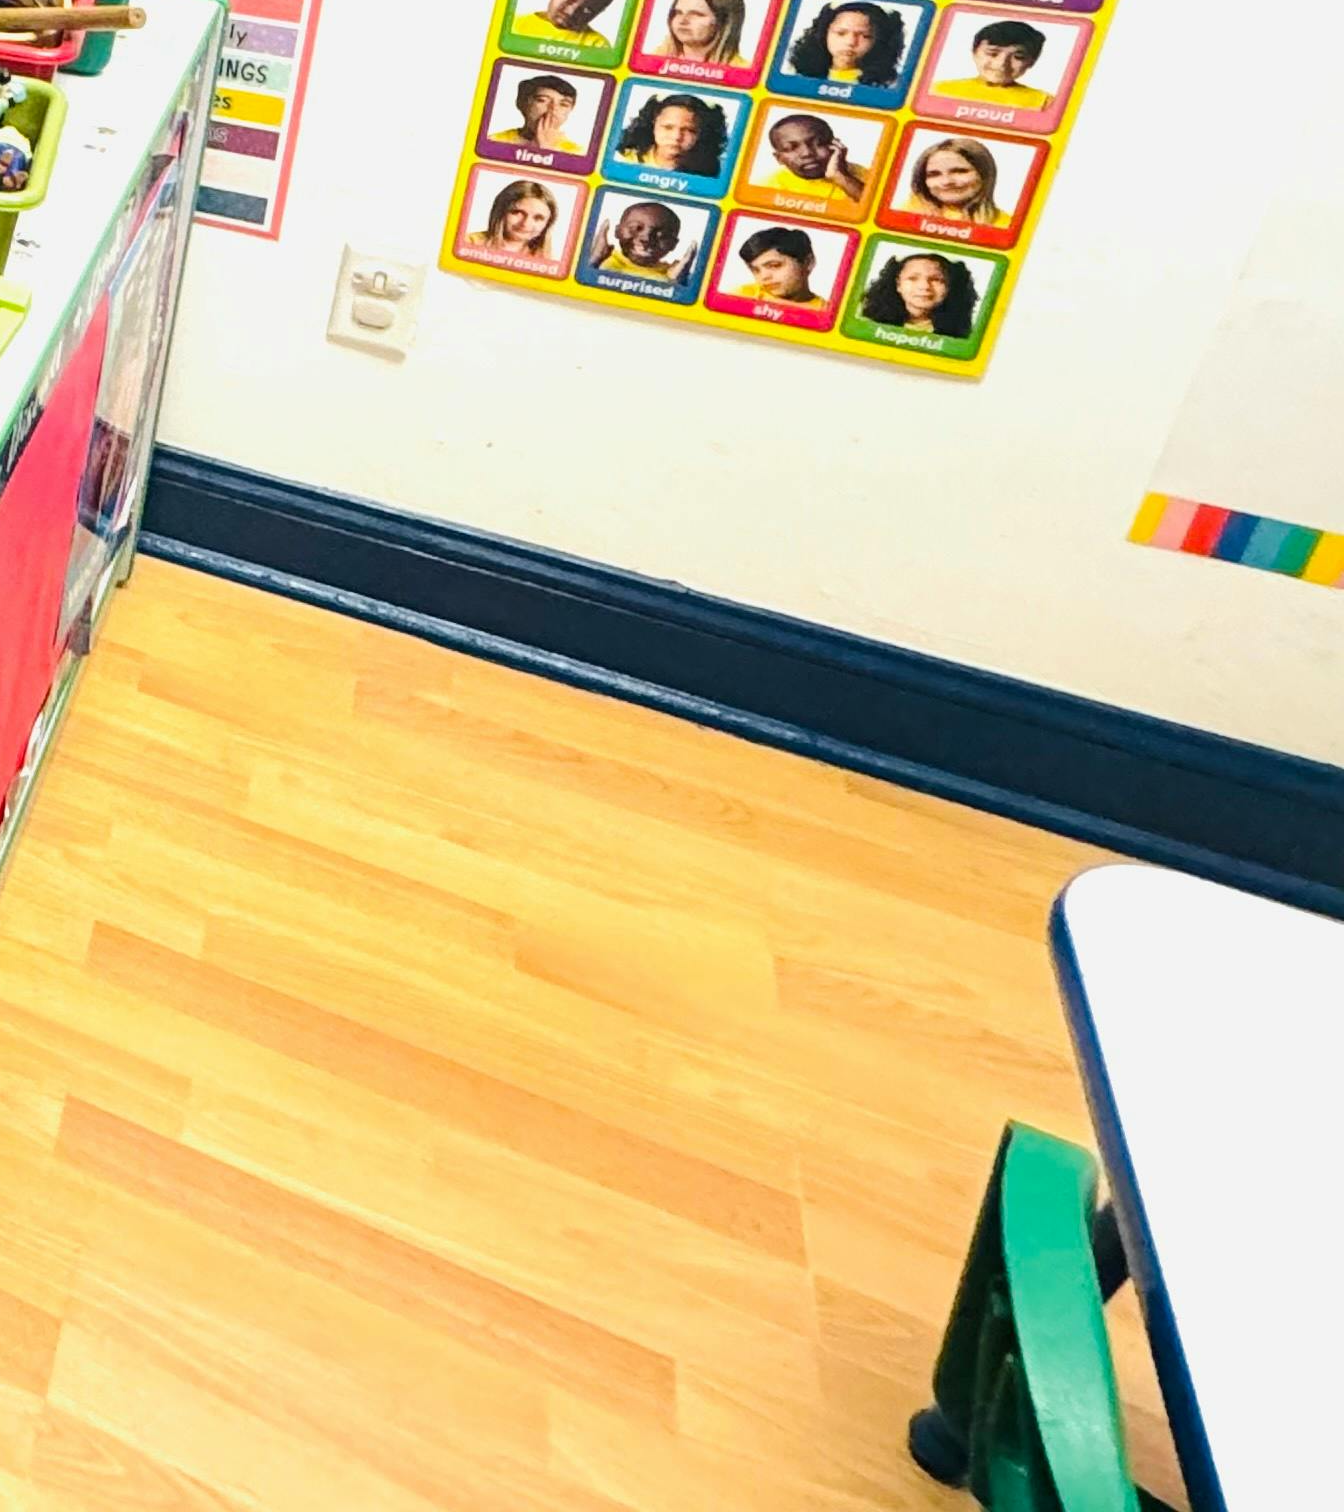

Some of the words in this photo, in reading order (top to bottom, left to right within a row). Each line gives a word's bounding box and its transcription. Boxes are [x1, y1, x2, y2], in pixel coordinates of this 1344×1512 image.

[537, 42, 581, 61] sorry
[659, 58, 726, 80] jealous
[818, 81, 853, 99] sad
[955, 104, 1016, 124] proud
[515, 147, 555, 167] tired
[638, 171, 690, 193] angry
[775, 193, 827, 215] bored
[919, 219, 973, 240] loved
[457, 244, 559, 276] embarrassed
[597, 274, 676, 300] surprised
[752, 304, 785, 321] shy
[874, 326, 944, 352] hopeful
